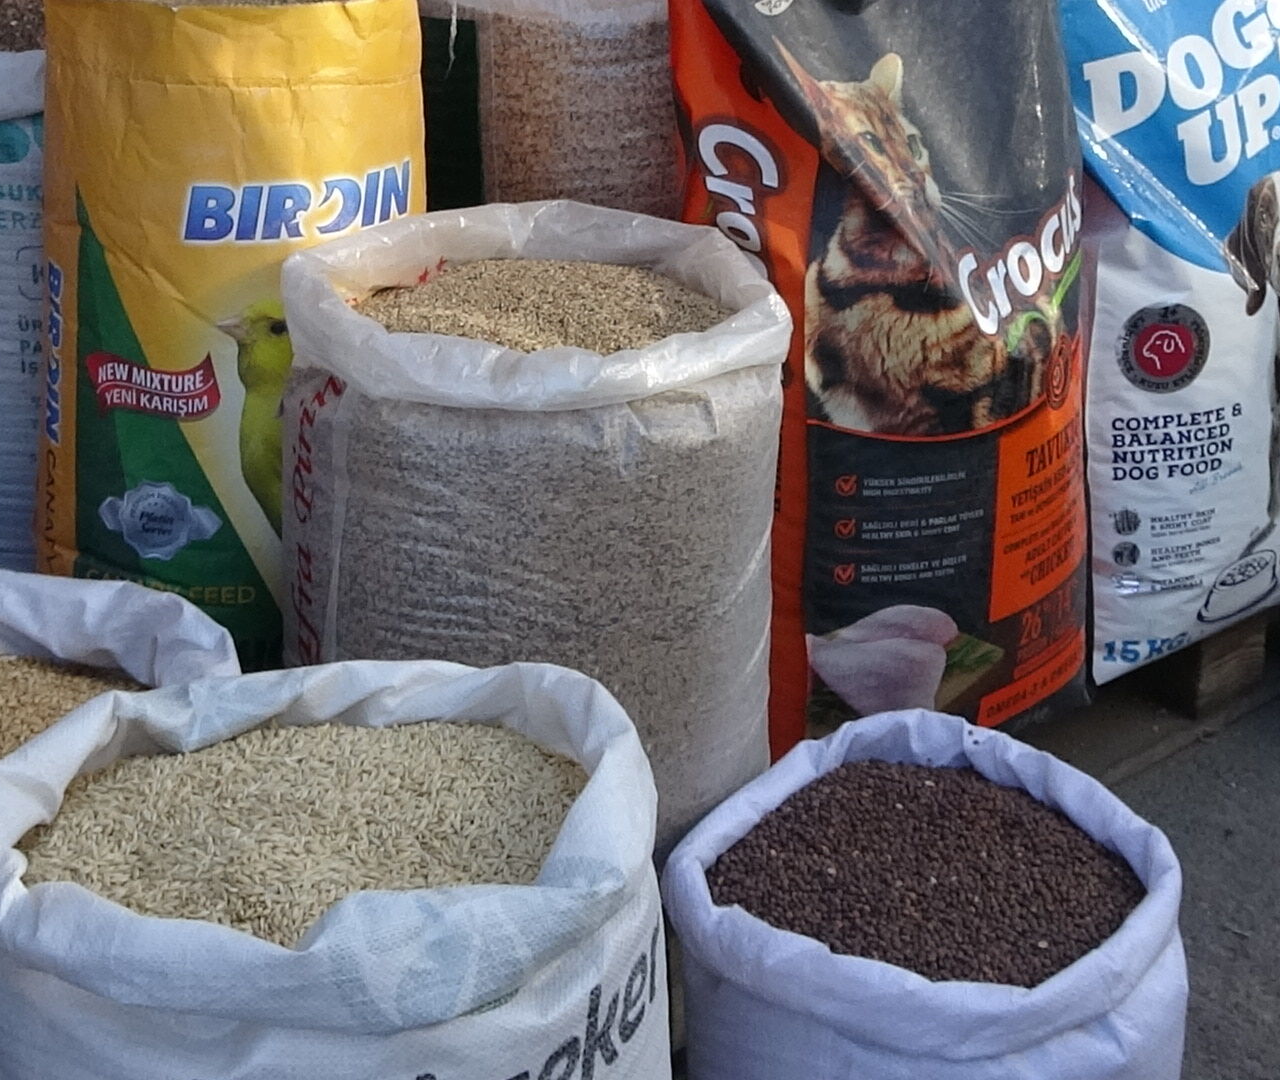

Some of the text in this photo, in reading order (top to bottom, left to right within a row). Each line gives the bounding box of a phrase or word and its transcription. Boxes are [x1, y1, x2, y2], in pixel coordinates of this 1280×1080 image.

[183, 159, 411, 243] BIRDIN
[698, 123, 780, 256] Cro
[98, 357, 204, 392] NEW MIXTURE
[105, 387, 209, 416] YENİ KARIŞIM
[1112, 403, 1243, 432] COMPLETE &
[1112, 423, 1230, 448] BALANCED
[1112, 438, 1233, 465] NUTRITION
[1112, 458, 1223, 482] DOG FOOD
[1150, 512, 1193, 524] HEALTHY
[1150, 543, 1193, 555] HEALTHY
[1102, 639, 1140, 664] 15
